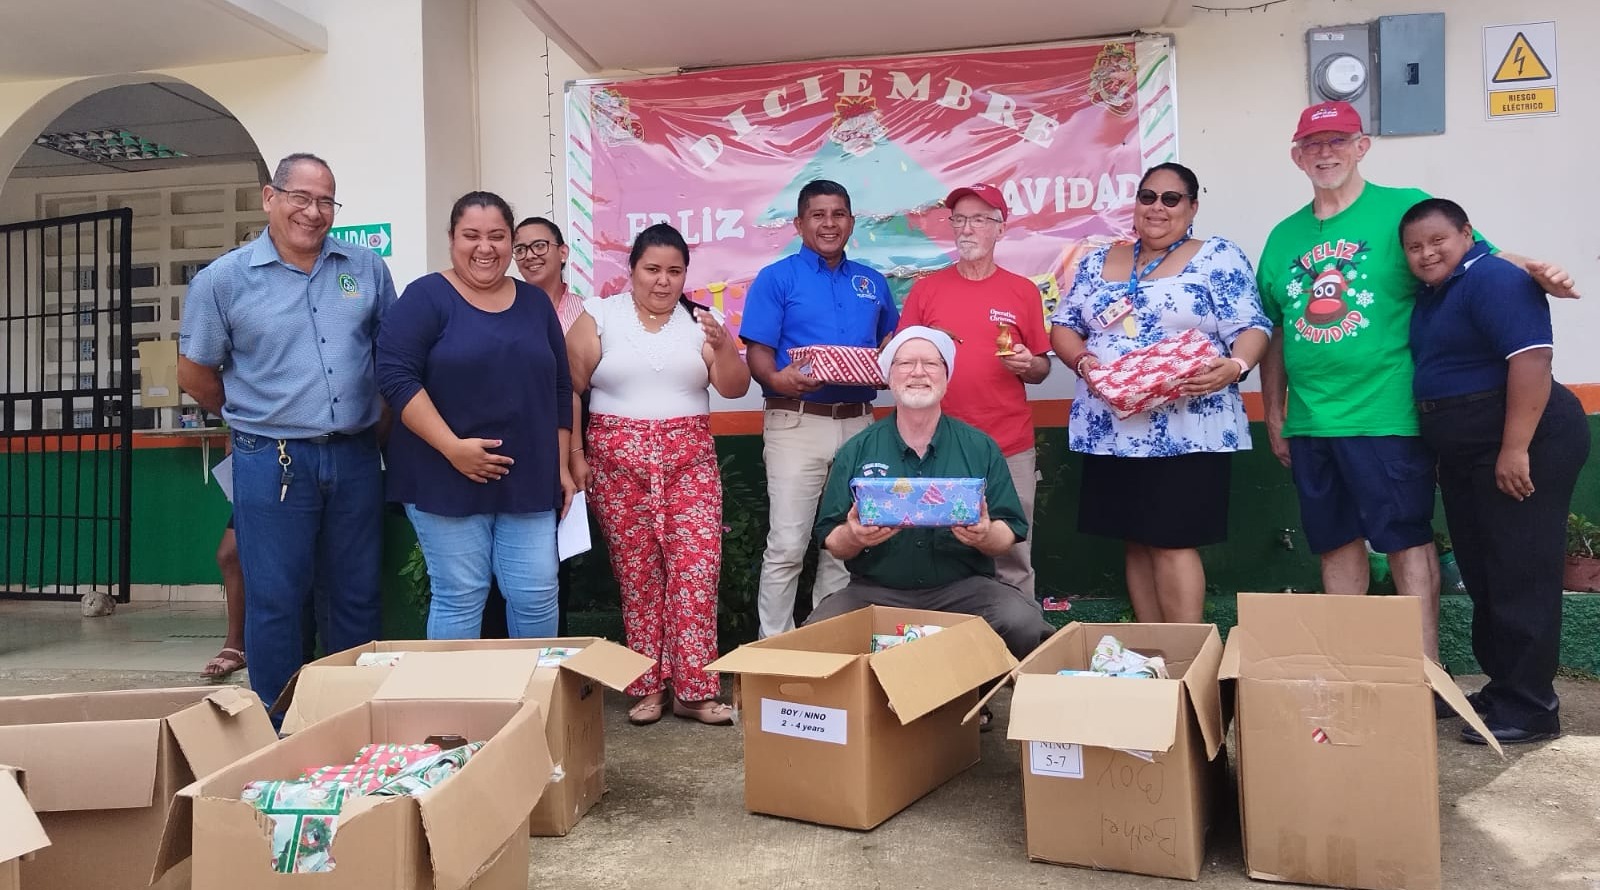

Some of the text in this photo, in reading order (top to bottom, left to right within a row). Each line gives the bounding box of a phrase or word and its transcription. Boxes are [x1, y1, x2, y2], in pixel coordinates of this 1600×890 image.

[1508, 94, 1537, 102] RIESGO
[689, 68, 1060, 169] DICIEMBRE
[1002, 173, 1141, 215] AVIDAD
[1301, 239, 1360, 269] FELIZ
[1295, 311, 1362, 343] NAVIDAD
[781, 708, 798, 717] BOY
[804, 712, 826, 720] NINO
[1046, 754, 1066, 767] 5-7
[1101, 814, 1176, 857] Bethel
